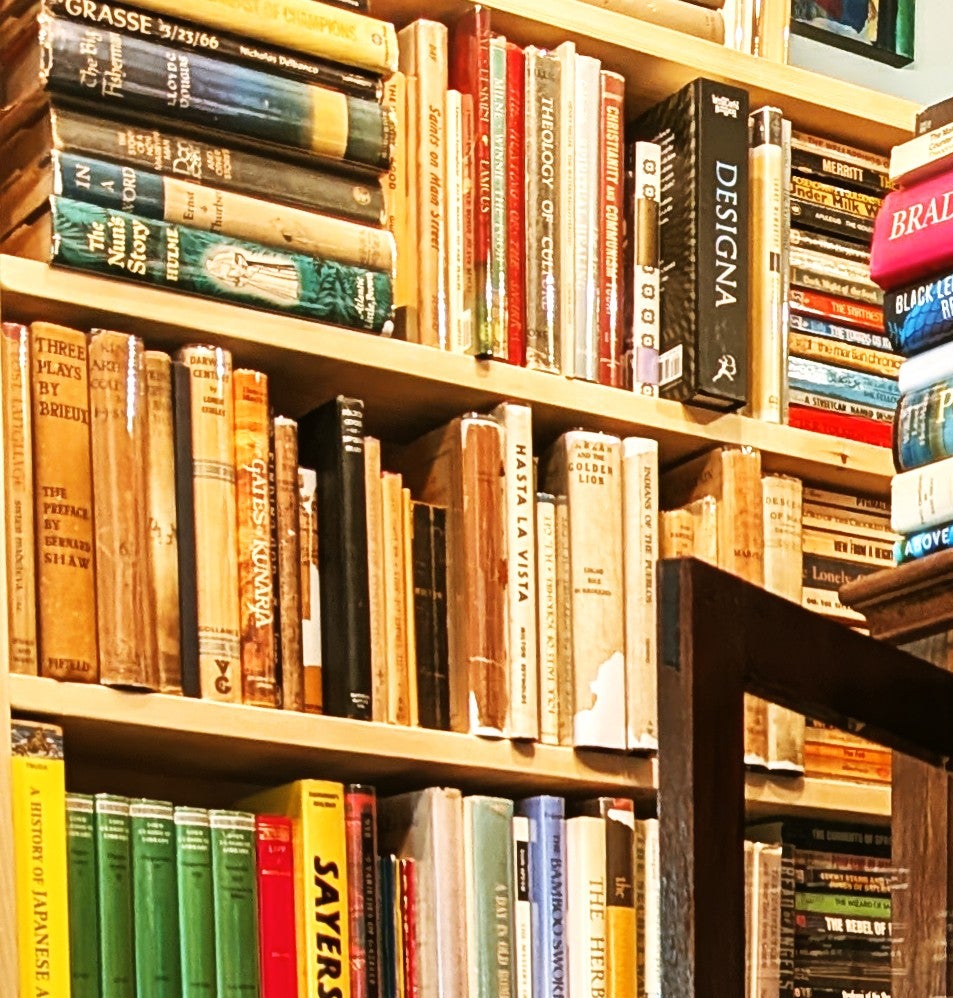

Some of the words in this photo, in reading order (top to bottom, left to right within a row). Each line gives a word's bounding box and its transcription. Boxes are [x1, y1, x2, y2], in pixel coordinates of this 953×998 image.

[65, 0, 152, 34] GRASSE
[240, 46, 276, 63] Nicholas
[80, 30, 102, 55] Big
[80, 58, 100, 88] The
[429, 105, 440, 143] Saints
[541, 98, 554, 189] THEOLOGY
[606, 105, 619, 185] CHRISTIANITY
[431, 152, 439, 168] on
[822, 159, 863, 181] MERRITT
[75, 163, 90, 190] IN
[101, 181, 114, 193] A
[122, 167, 136, 215] WORD
[542, 200, 554, 222] OF
[87, 222, 105, 251] The
[108, 216, 126, 268] Nun's
[715, 161, 738, 308] DESIGNA
[127, 220, 150, 275] Story
[166, 228, 179, 281] HULME
[895, 283, 934, 314] BLACK
[35, 337, 86, 362] THREE
[834, 346, 867, 362] martian
[37, 360, 81, 380] PLAYS
[39, 381, 59, 396] BY
[515, 444, 527, 505] HASTA
[42, 486, 67, 499] THE
[644, 466, 652, 509] INDIANS
[43, 502, 88, 519] PREFACE
[645, 515, 652, 528] OF
[44, 519, 60, 531] BY
[518, 516, 528, 539] LA
[45, 536, 91, 553] BERNARD
[904, 527, 949, 556] ABOVE
[44, 553, 90, 569] SHAW
[518, 550, 529, 603] VISTA
[812, 566, 851, 584] Lonely
[30, 787, 41, 795] A
[31, 804, 44, 860] HISTORY
[34, 864, 44, 880] OF
[590, 877, 604, 922] THE
[614, 877, 631, 898] the
[32, 883, 50, 972] JAPANESE
[825, 916, 843, 932] THE
